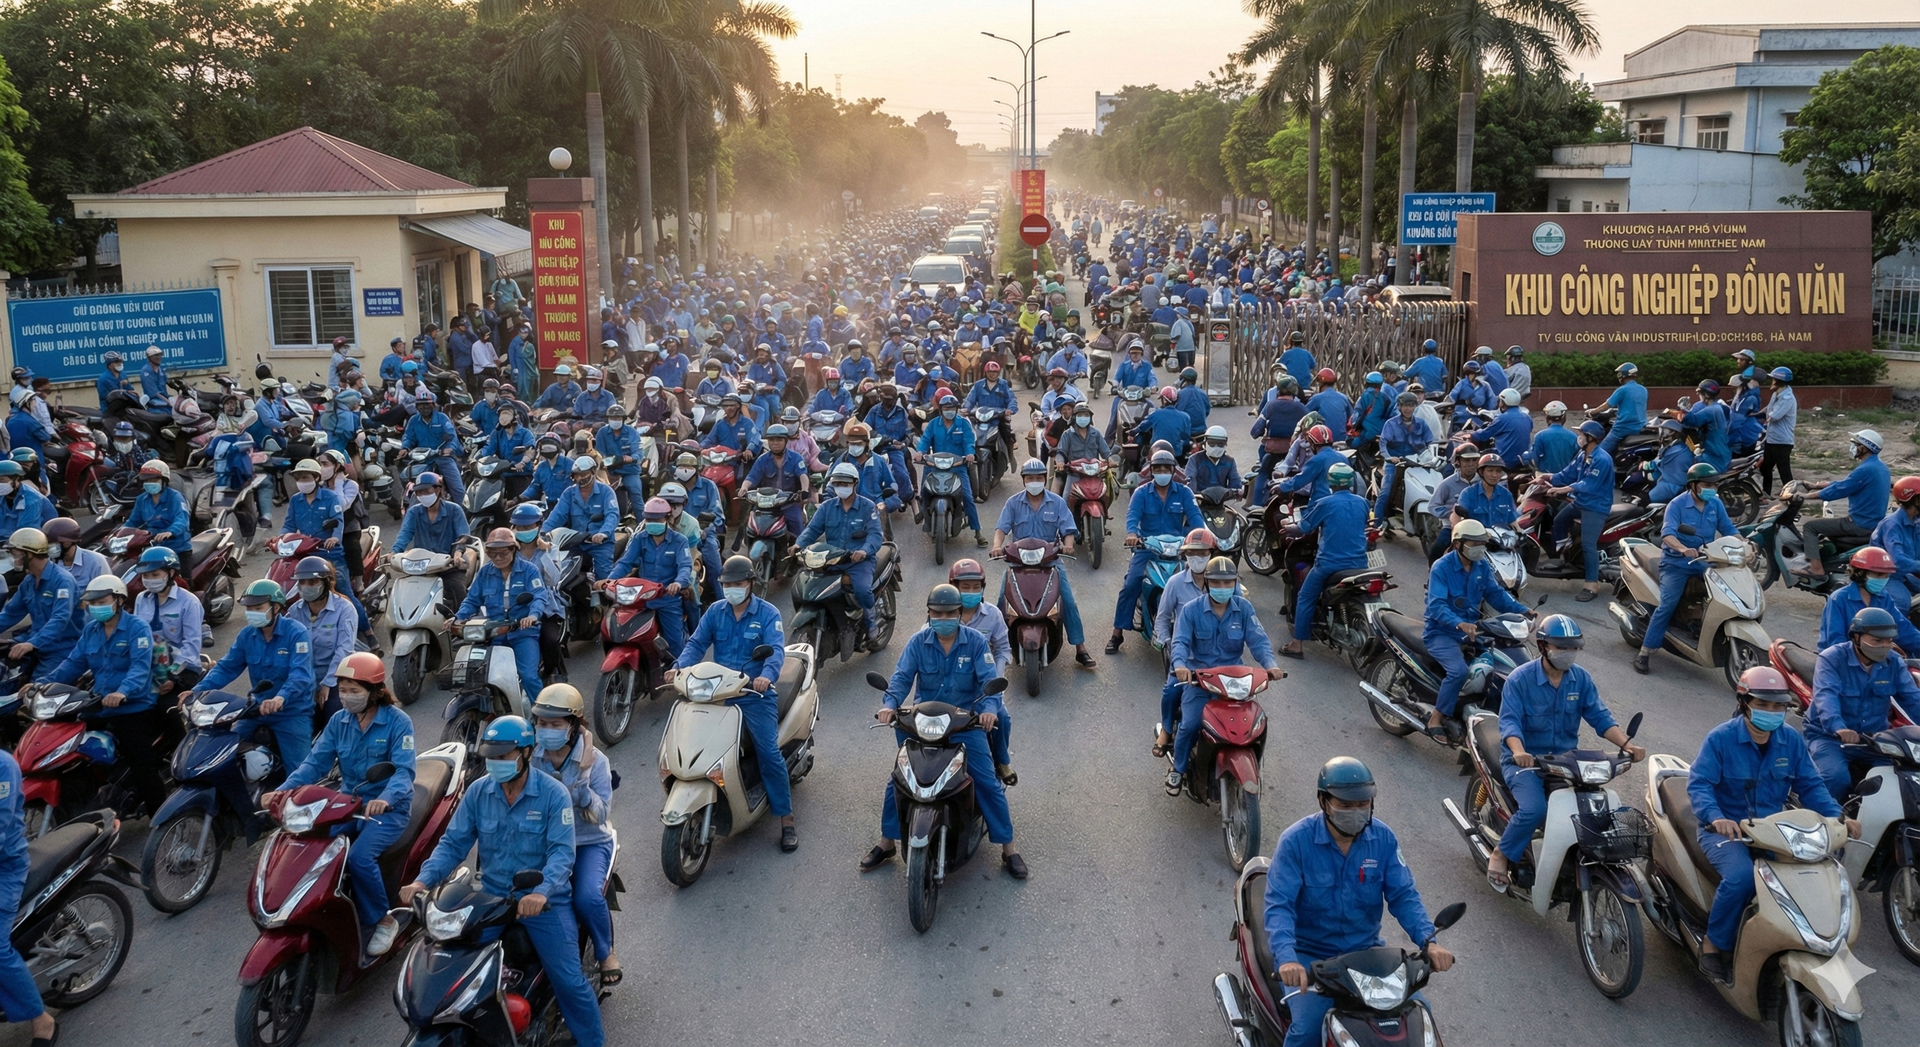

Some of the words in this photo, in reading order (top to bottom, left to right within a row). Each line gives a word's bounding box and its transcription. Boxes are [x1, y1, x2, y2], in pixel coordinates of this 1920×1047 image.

[548, 219, 565, 231] KHU
[1741, 239, 1766, 248] NAM
[1504, 273, 1553, 315] KHU
[1560, 264, 1625, 315] CÔNG
[1632, 264, 1719, 324] NGHIỆP
[1725, 258, 1791, 315] ĐỒNG
[1797, 263, 1845, 315] VĂN
[1538, 333, 1551, 343] TV
[1770, 330, 1786, 342] HÀ
[1788, 332, 1812, 342] NAM
